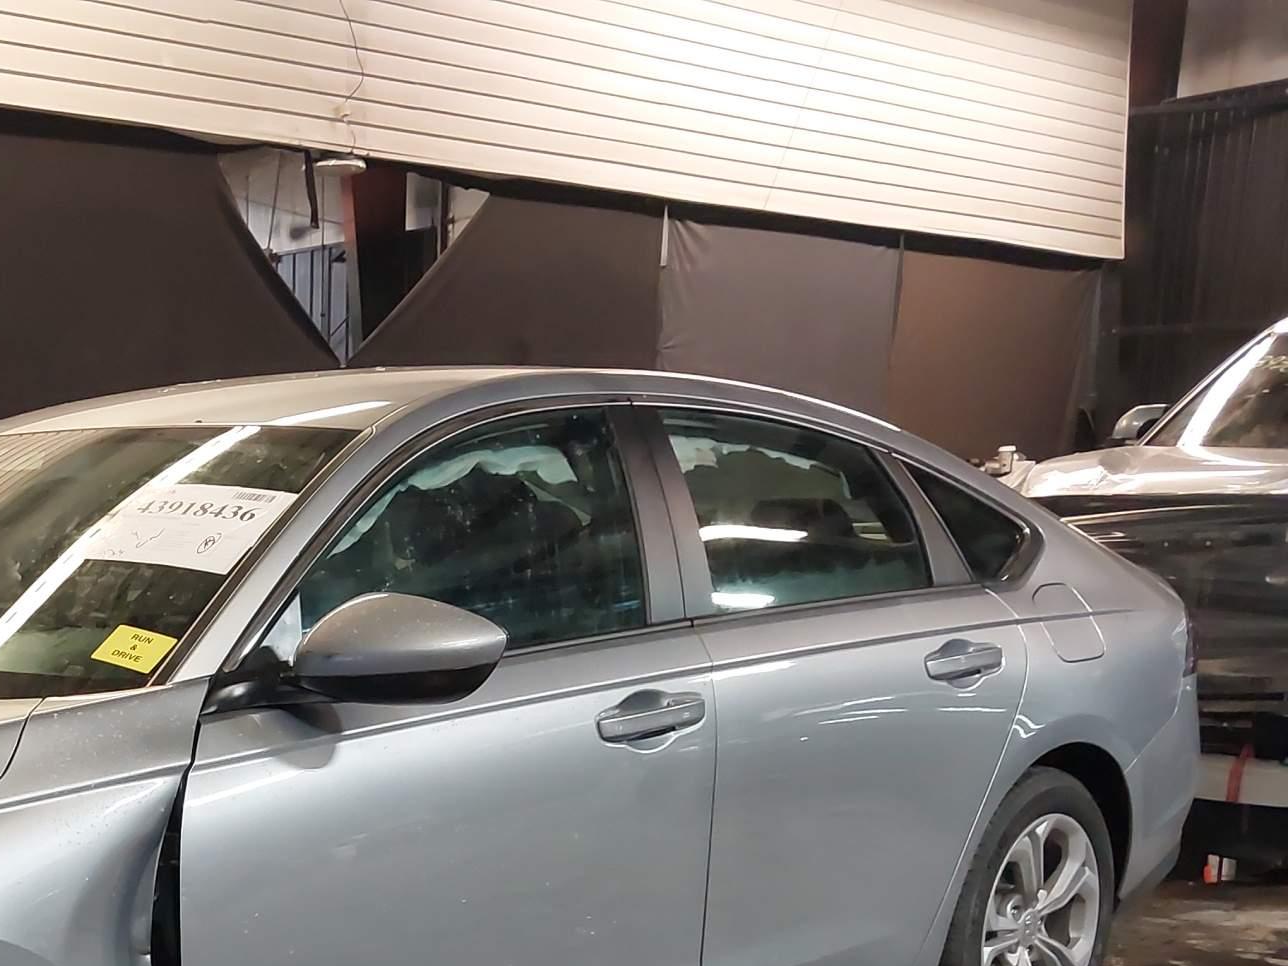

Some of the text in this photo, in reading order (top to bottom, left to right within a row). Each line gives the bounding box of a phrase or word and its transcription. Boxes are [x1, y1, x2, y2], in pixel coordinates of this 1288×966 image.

[137, 499, 261, 522] 43918436
[131, 633, 154, 645] RUN
[111, 649, 143, 663] DRIVE
